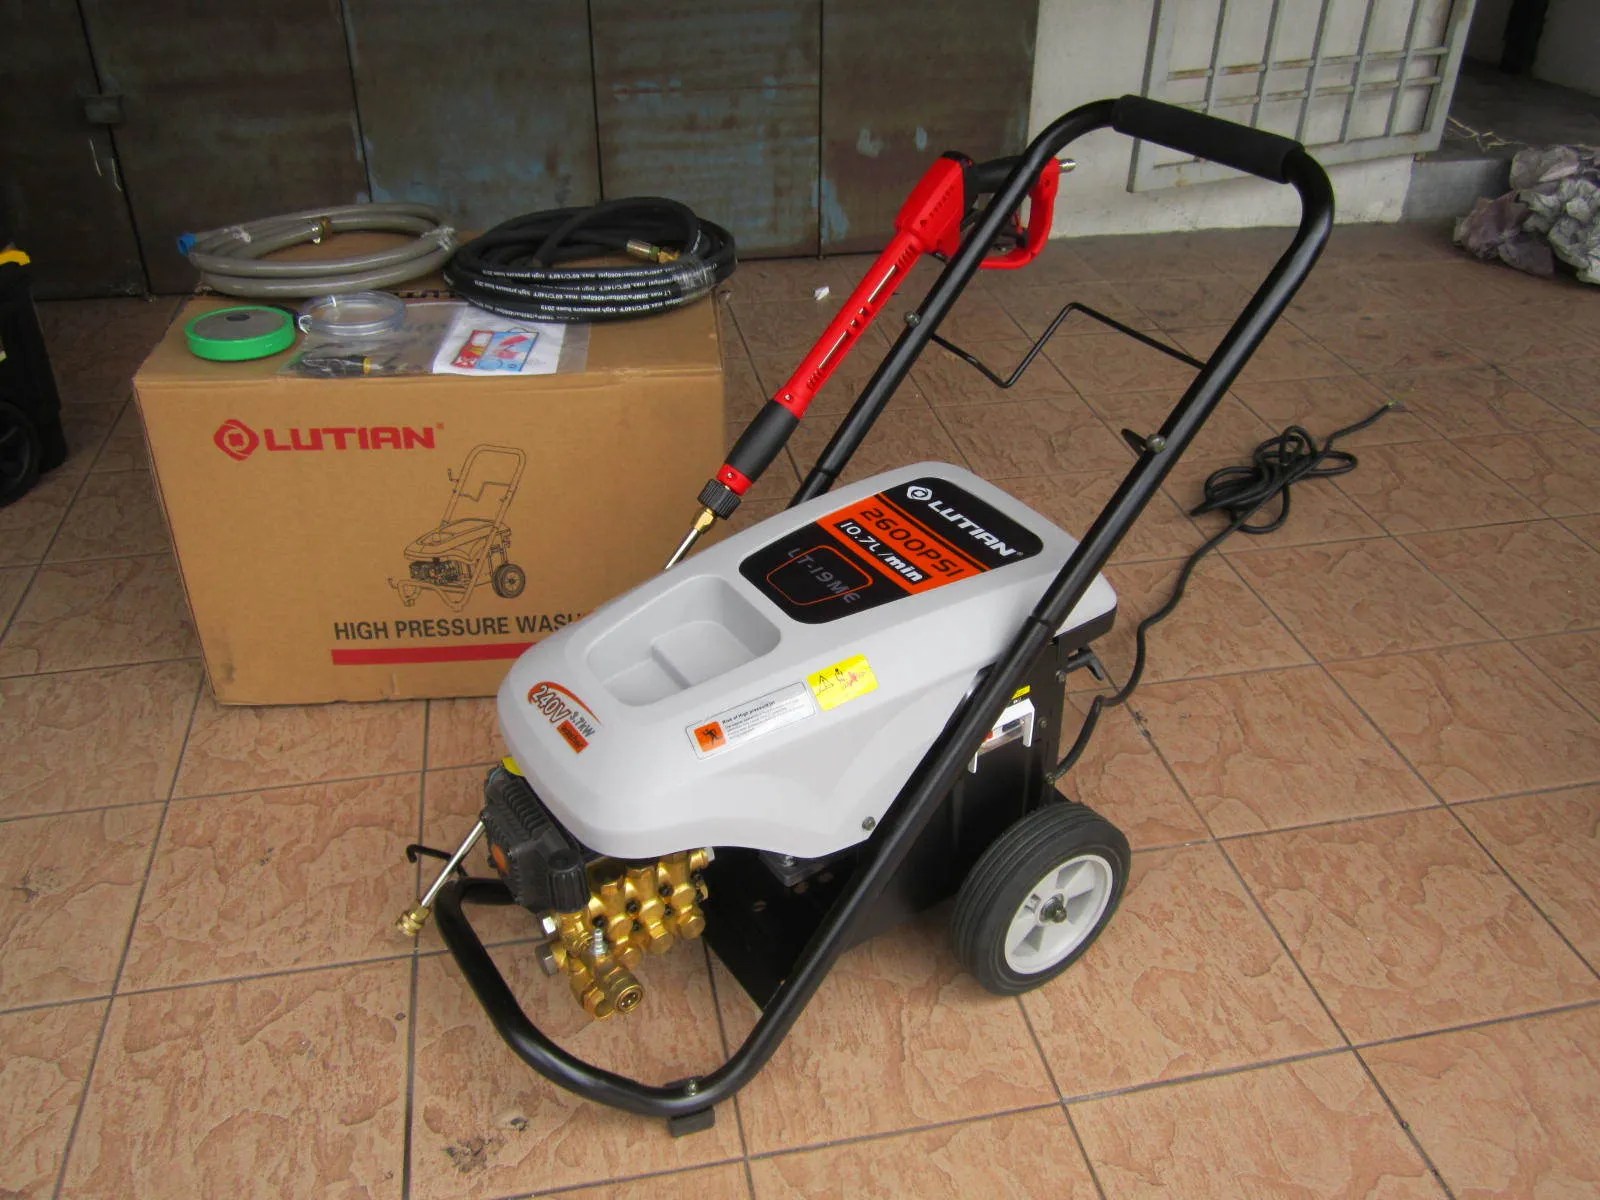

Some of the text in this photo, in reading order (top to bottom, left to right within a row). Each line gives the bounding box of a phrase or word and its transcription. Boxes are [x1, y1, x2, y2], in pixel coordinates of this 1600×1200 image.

[264, 426, 435, 451] LUTIAN
[860, 507, 967, 579] 2600PSI
[927, 499, 1017, 557] LUTIAN
[787, 547, 862, 604] LT-19ME
[333, 620, 388, 641] HIGH
[396, 615, 509, 639] PRESSURE
[531, 684, 572, 723] 240V
